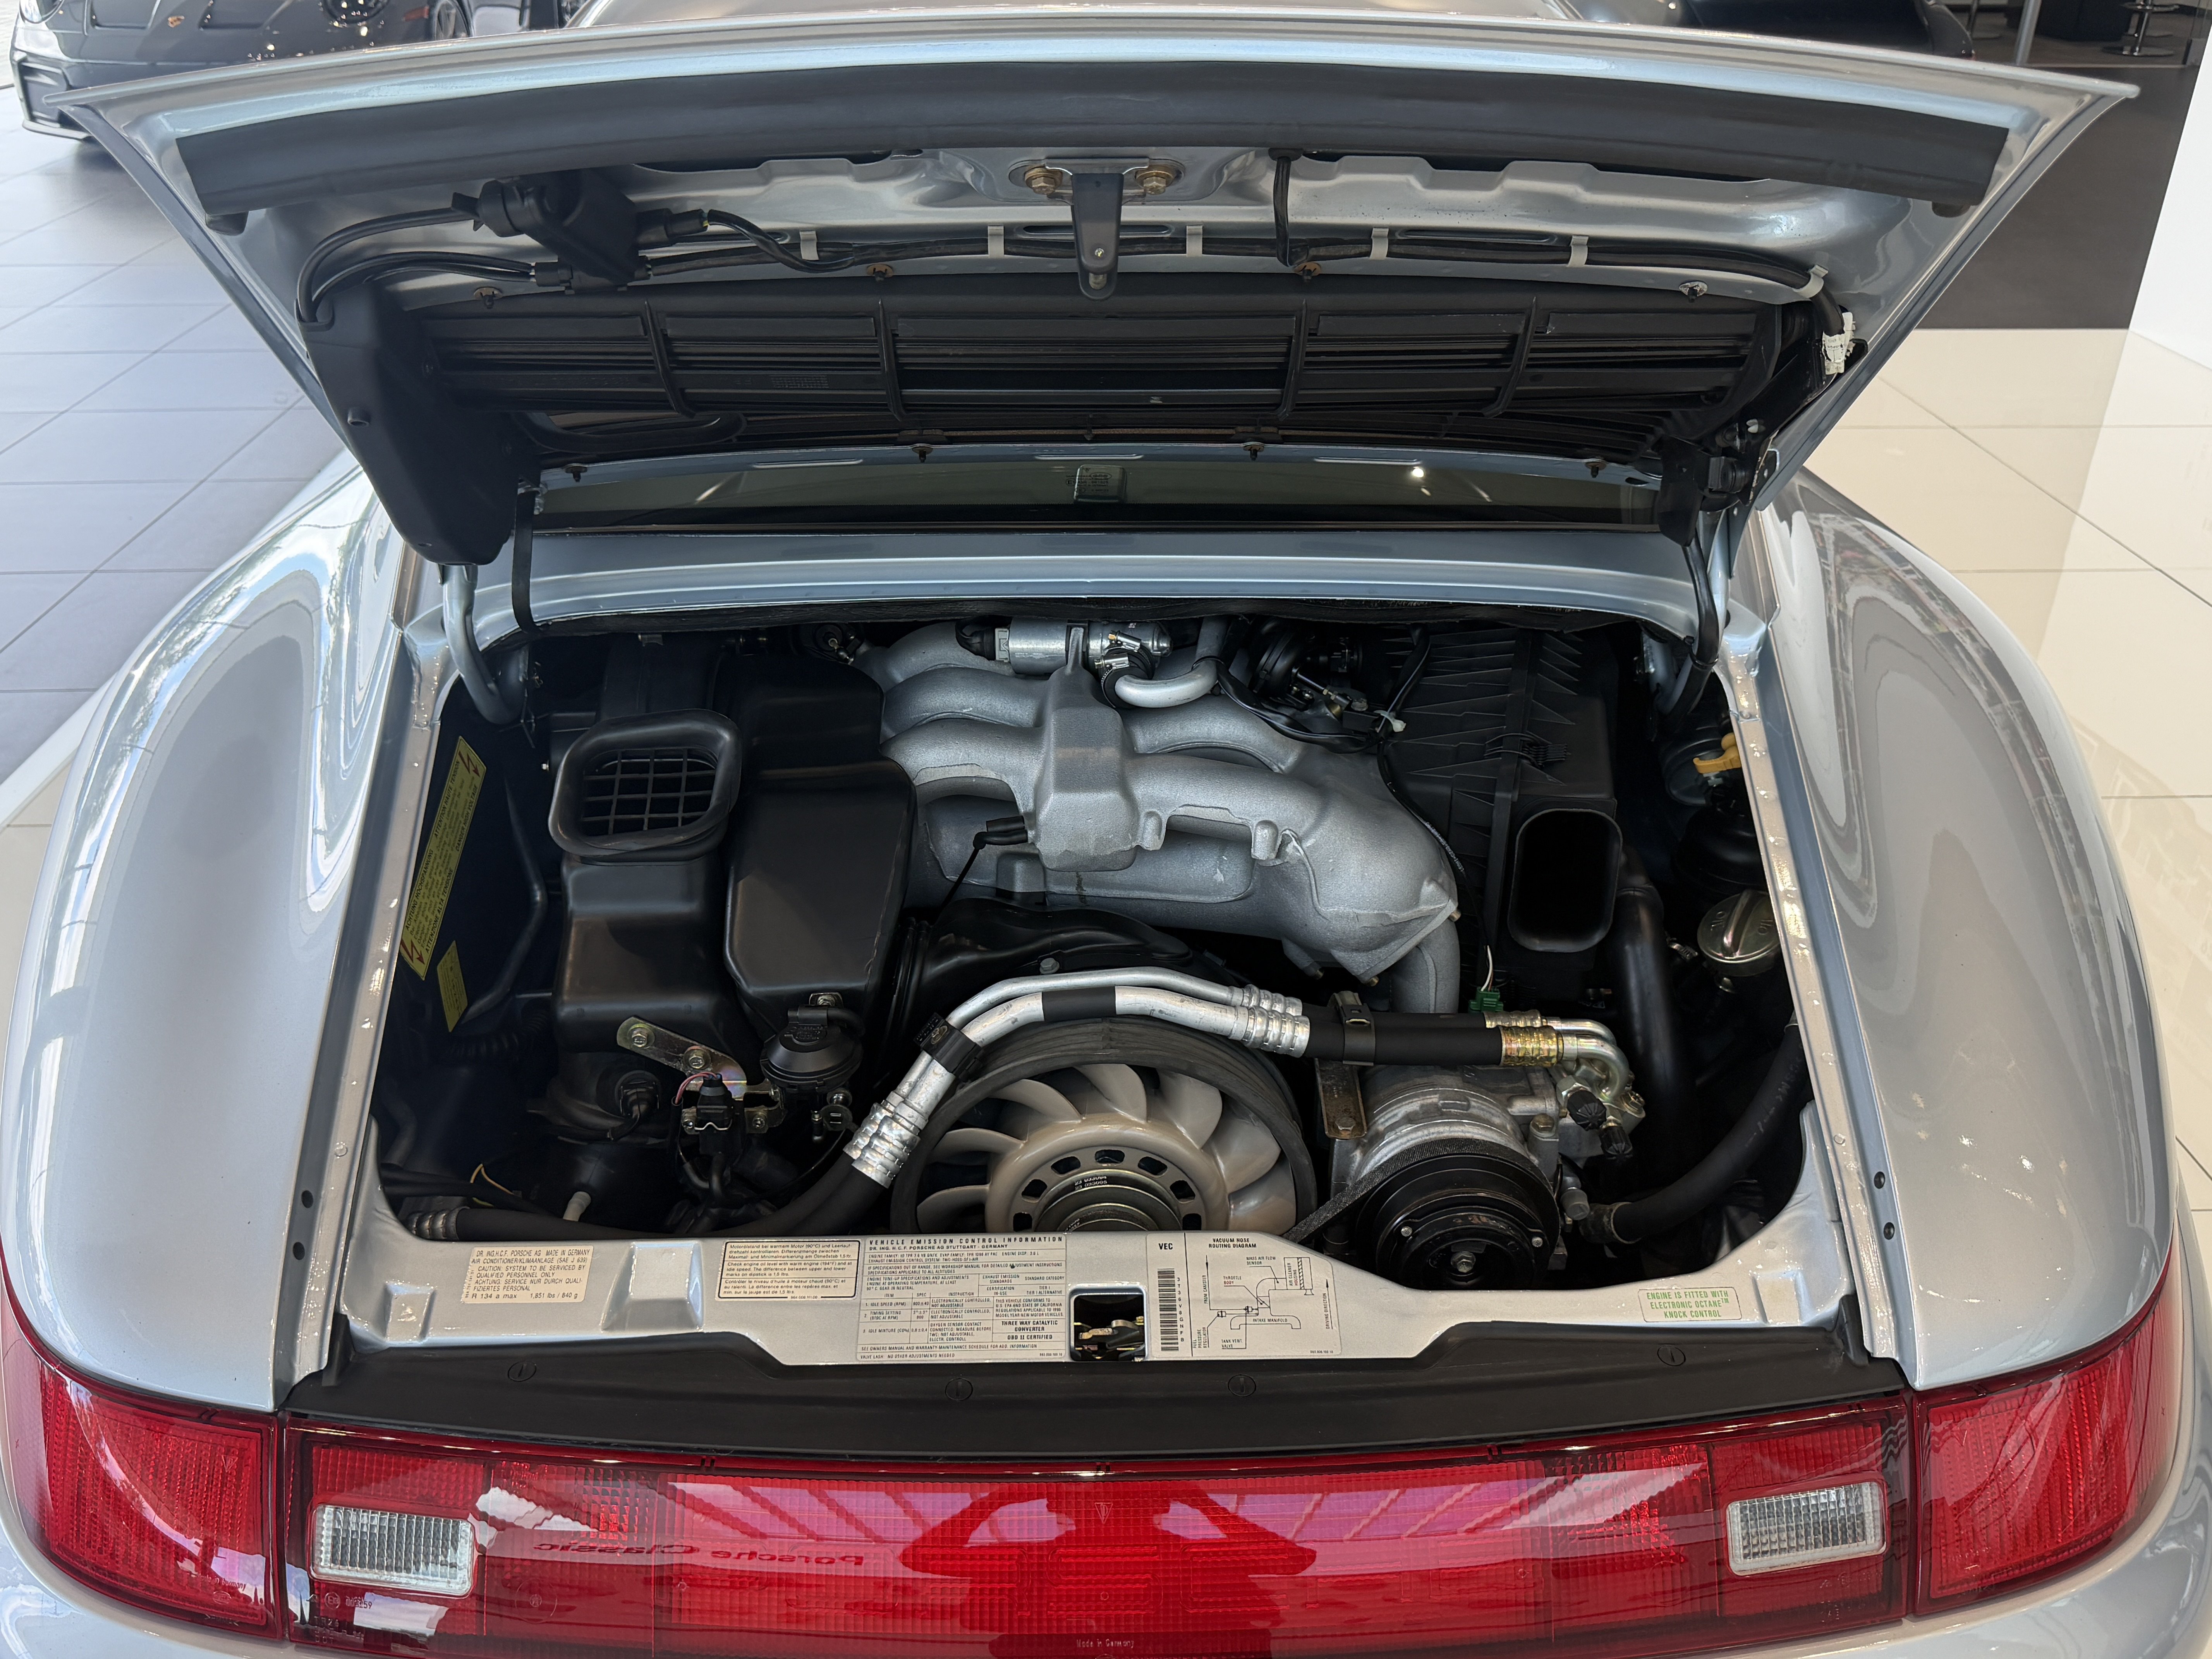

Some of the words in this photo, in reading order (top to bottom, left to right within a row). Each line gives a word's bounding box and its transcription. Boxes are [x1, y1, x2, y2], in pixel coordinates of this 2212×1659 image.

[434, 804, 447, 838] ATTENTION
[444, 785, 453, 805] HAUTE
[450, 760, 460, 784] TENSION
[455, 826, 465, 851] DANGER
[467, 784, 477, 811] VOLTAGE
[405, 900, 417, 930] ACHTUNG
[416, 848, 433, 899] HOCHSPANNUNG
[426, 915, 439, 953] ATTENZIONE
[442, 867, 453, 897] TENSIONE
[1077, 1639, 1093, 1647] Made
[1106, 1638, 1134, 1648] Germany
